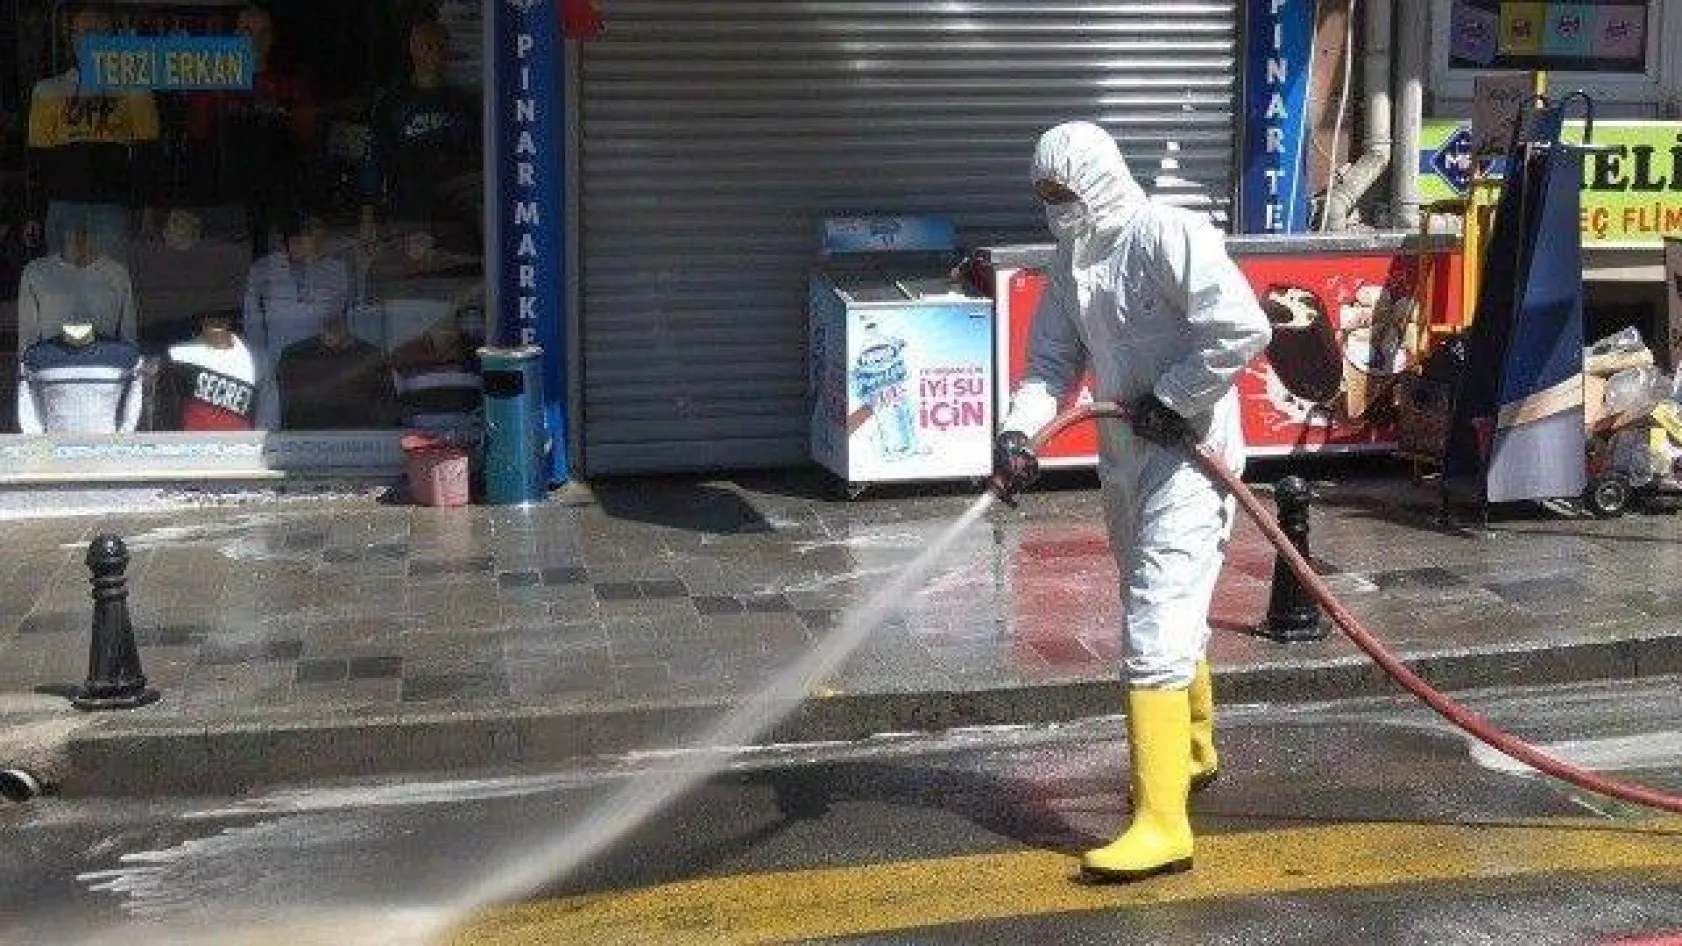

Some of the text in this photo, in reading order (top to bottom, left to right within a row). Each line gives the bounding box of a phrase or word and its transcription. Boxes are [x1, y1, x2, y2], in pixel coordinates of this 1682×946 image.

[165, 51, 243, 86] ERKAN
[515, 33, 537, 187] PINAR
[919, 378, 948, 398] İYİ
[953, 378, 984, 396] SU
[919, 399, 984, 432] İÇİN
